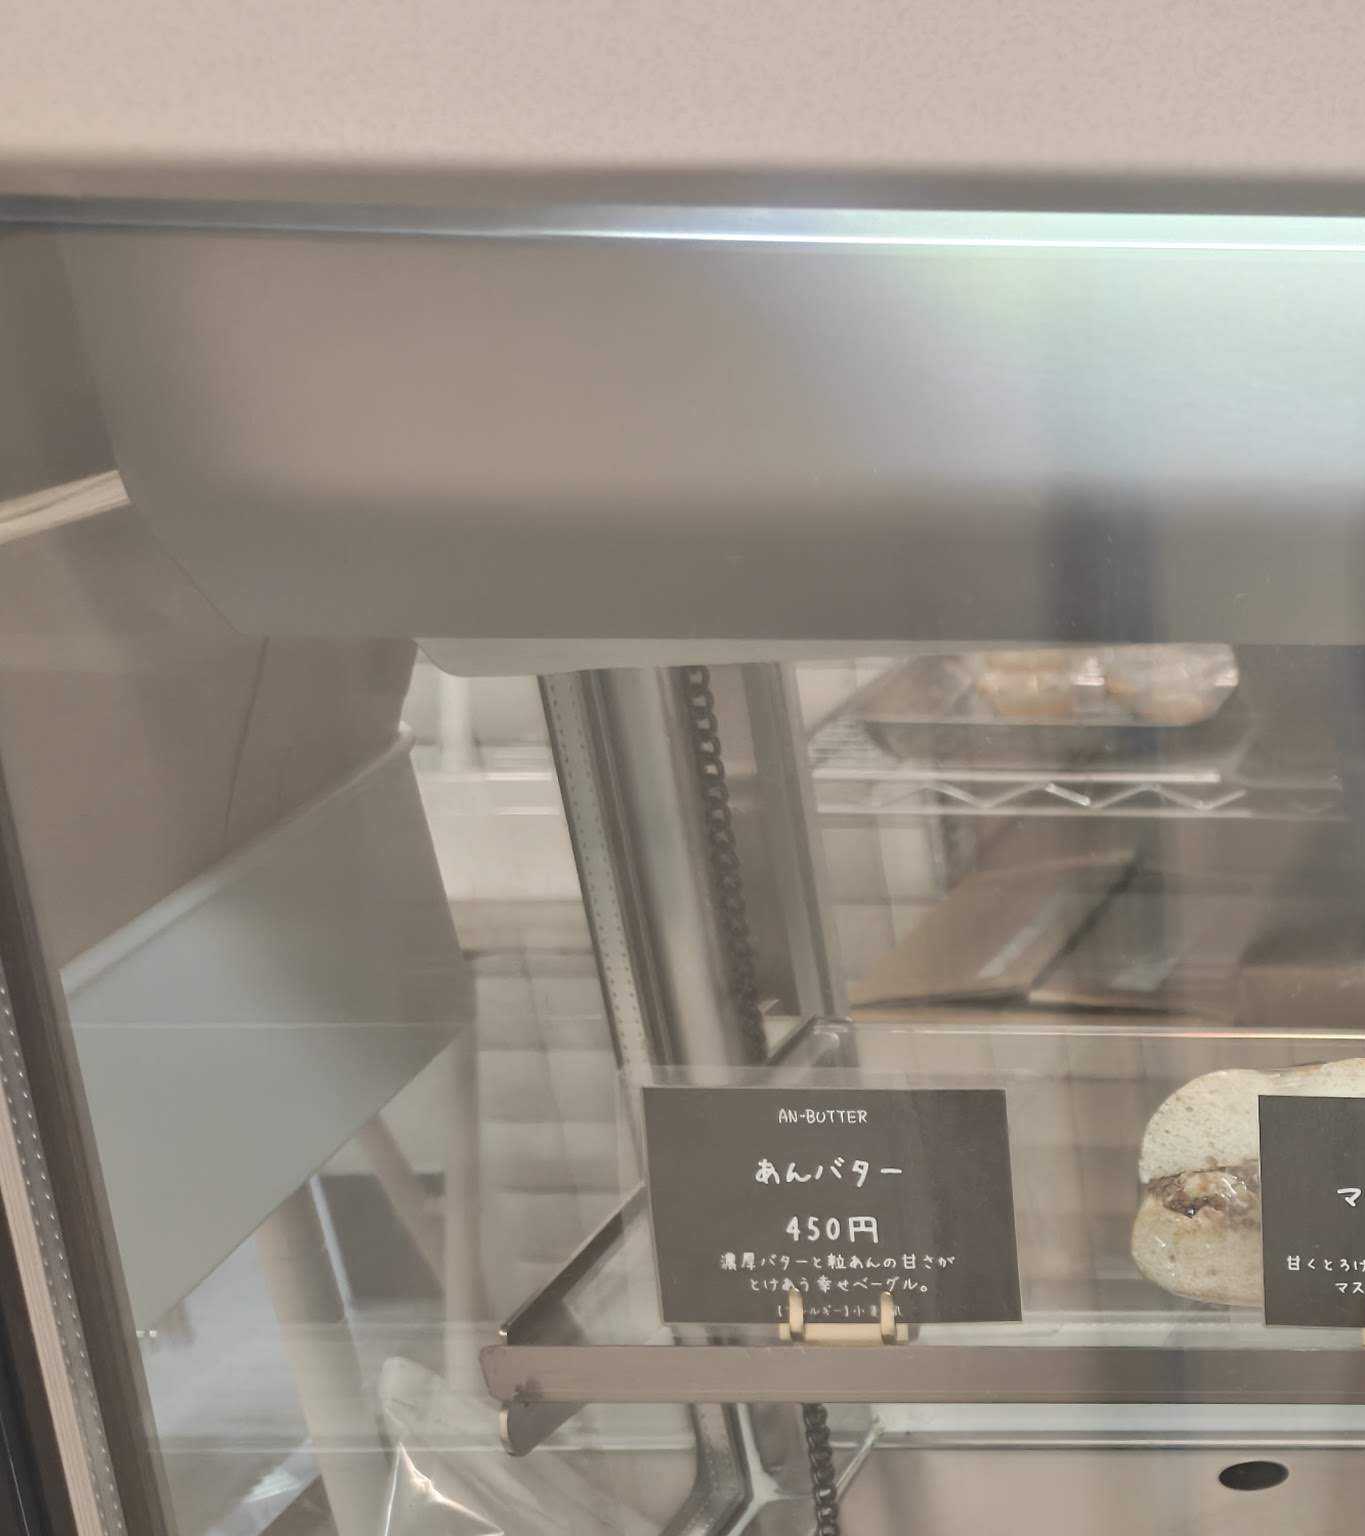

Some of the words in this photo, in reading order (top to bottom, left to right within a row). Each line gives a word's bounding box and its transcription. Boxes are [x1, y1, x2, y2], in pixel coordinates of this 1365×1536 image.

[778, 1108, 868, 1125] AN-BUTTER
[755, 1157, 902, 1187] あんバター
[785, 1216, 878, 1244] 450円
[720, 1252, 955, 1271] 濃厚バターと粒あんの甘さが
[750, 1274, 928, 1292] とけあう幸せベーグル。
